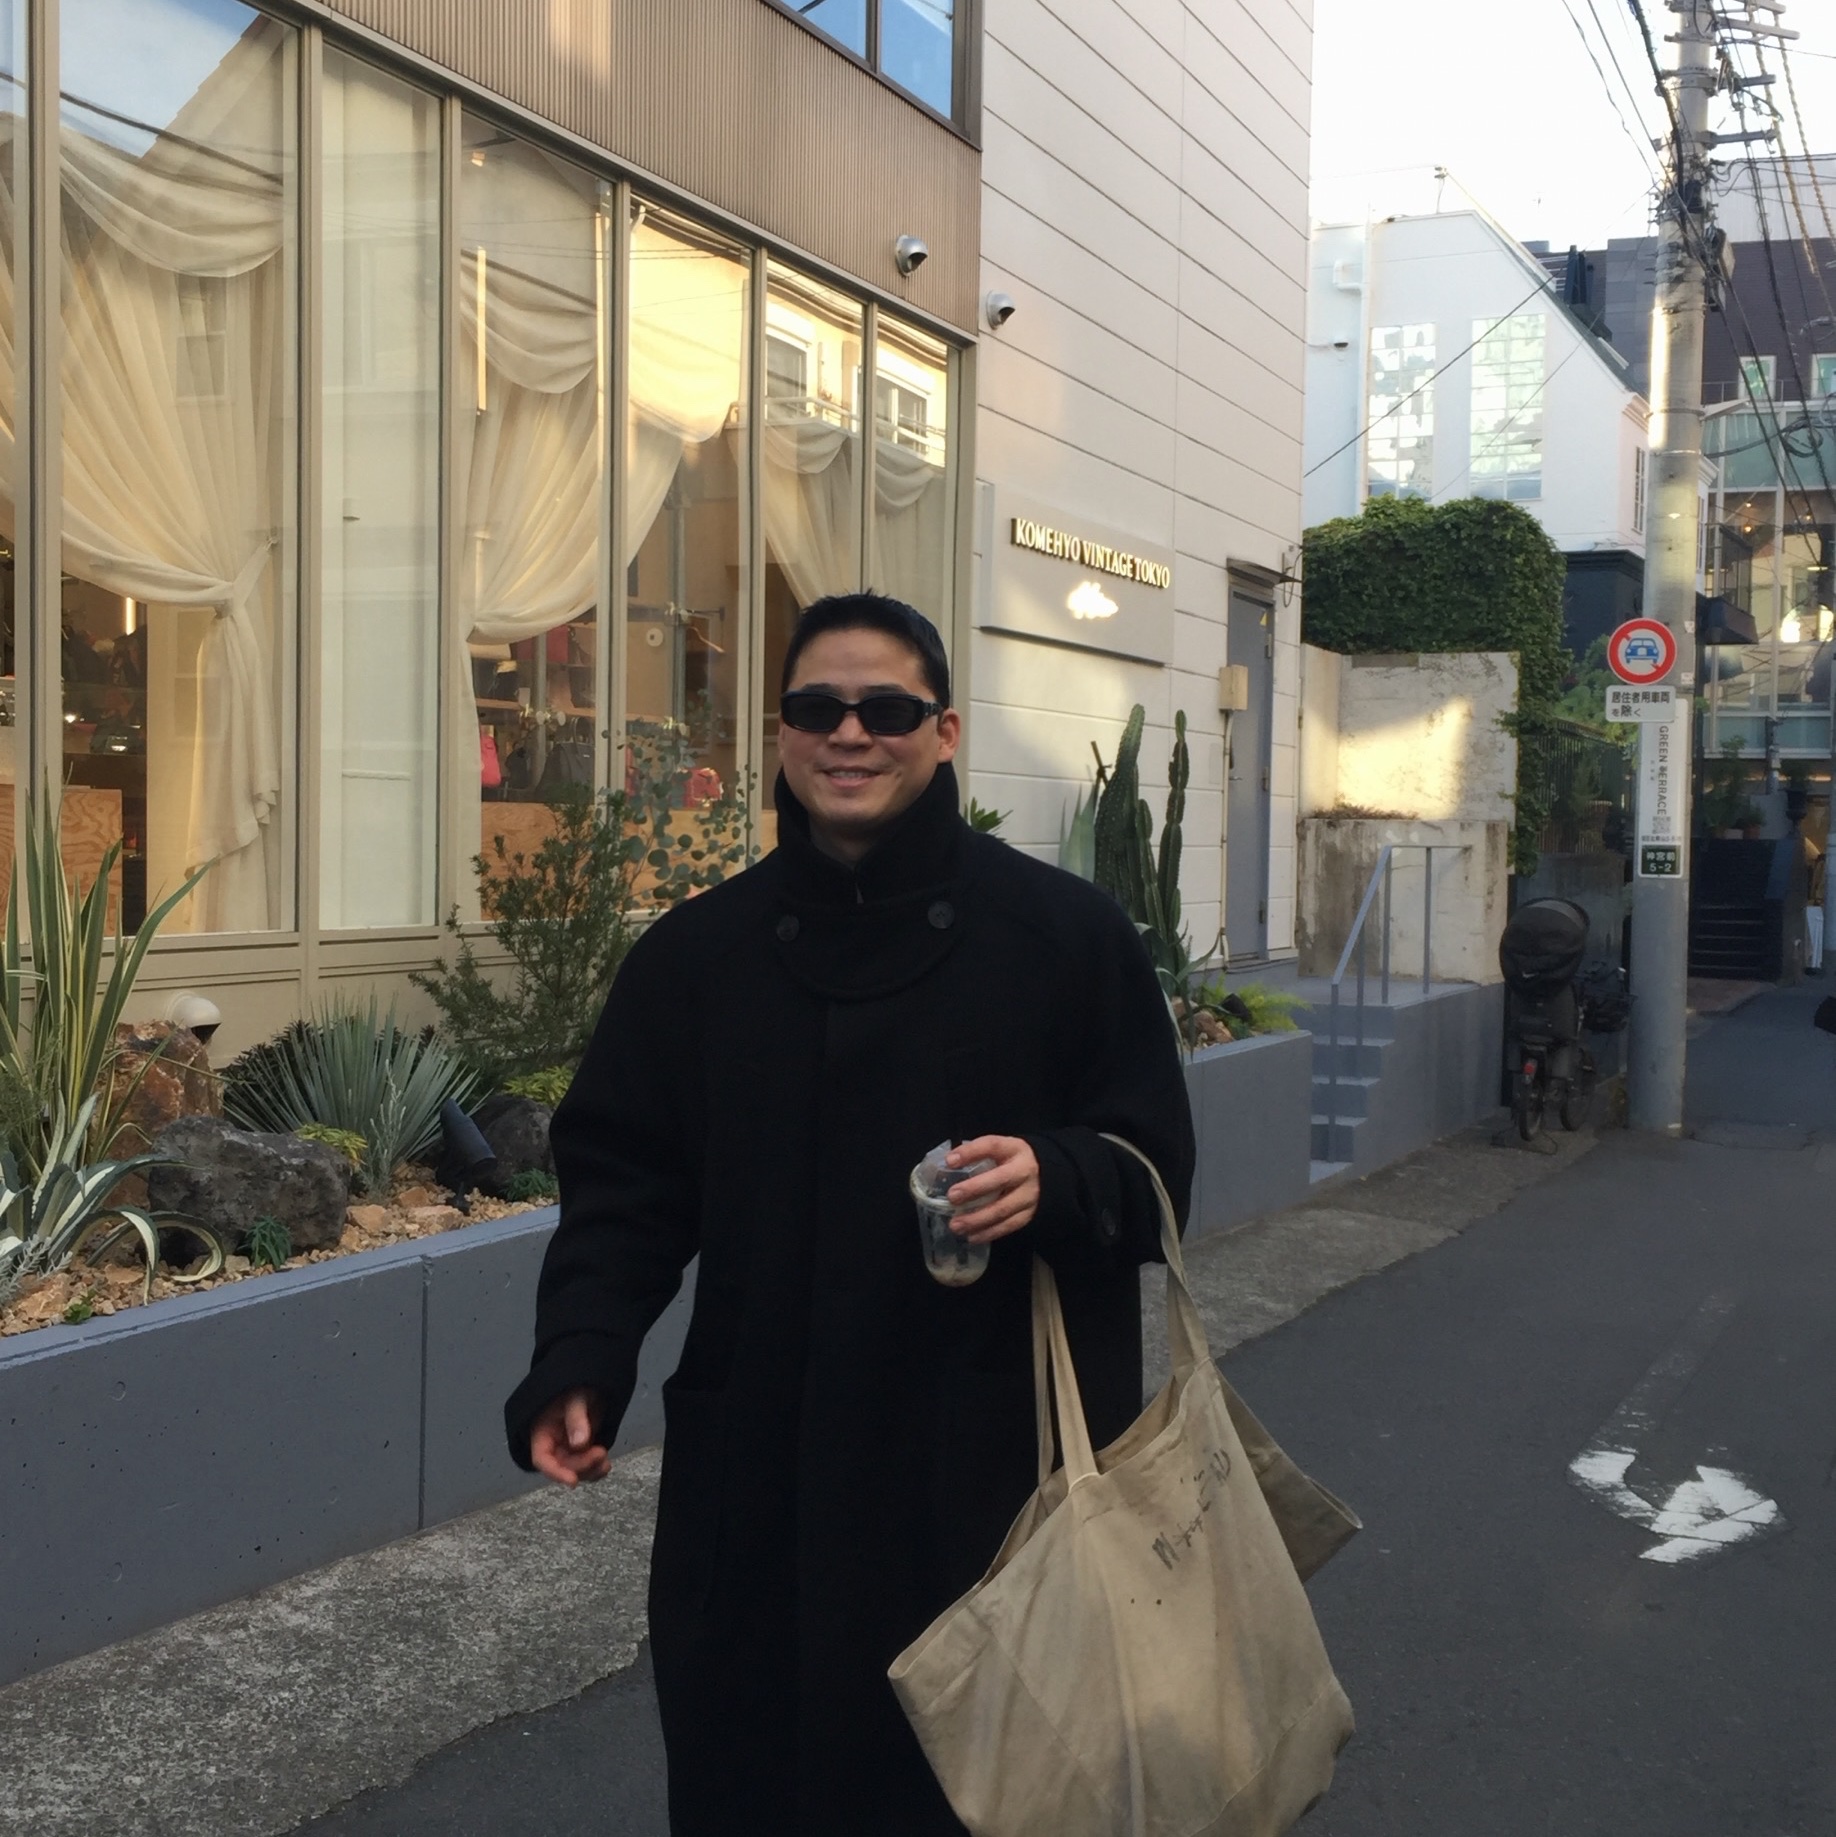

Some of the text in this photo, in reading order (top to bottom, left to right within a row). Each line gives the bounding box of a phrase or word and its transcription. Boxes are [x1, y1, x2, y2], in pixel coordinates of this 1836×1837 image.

[1014, 517, 1170, 589] KOMEHYO VINTAGE TOKYO
[1611, 691, 1671, 704] 居住者用車両
[1611, 704, 1641, 718] を除く
[1658, 725, 1669, 764] GREEN
[1649, 862, 1672, 872] 5-2
